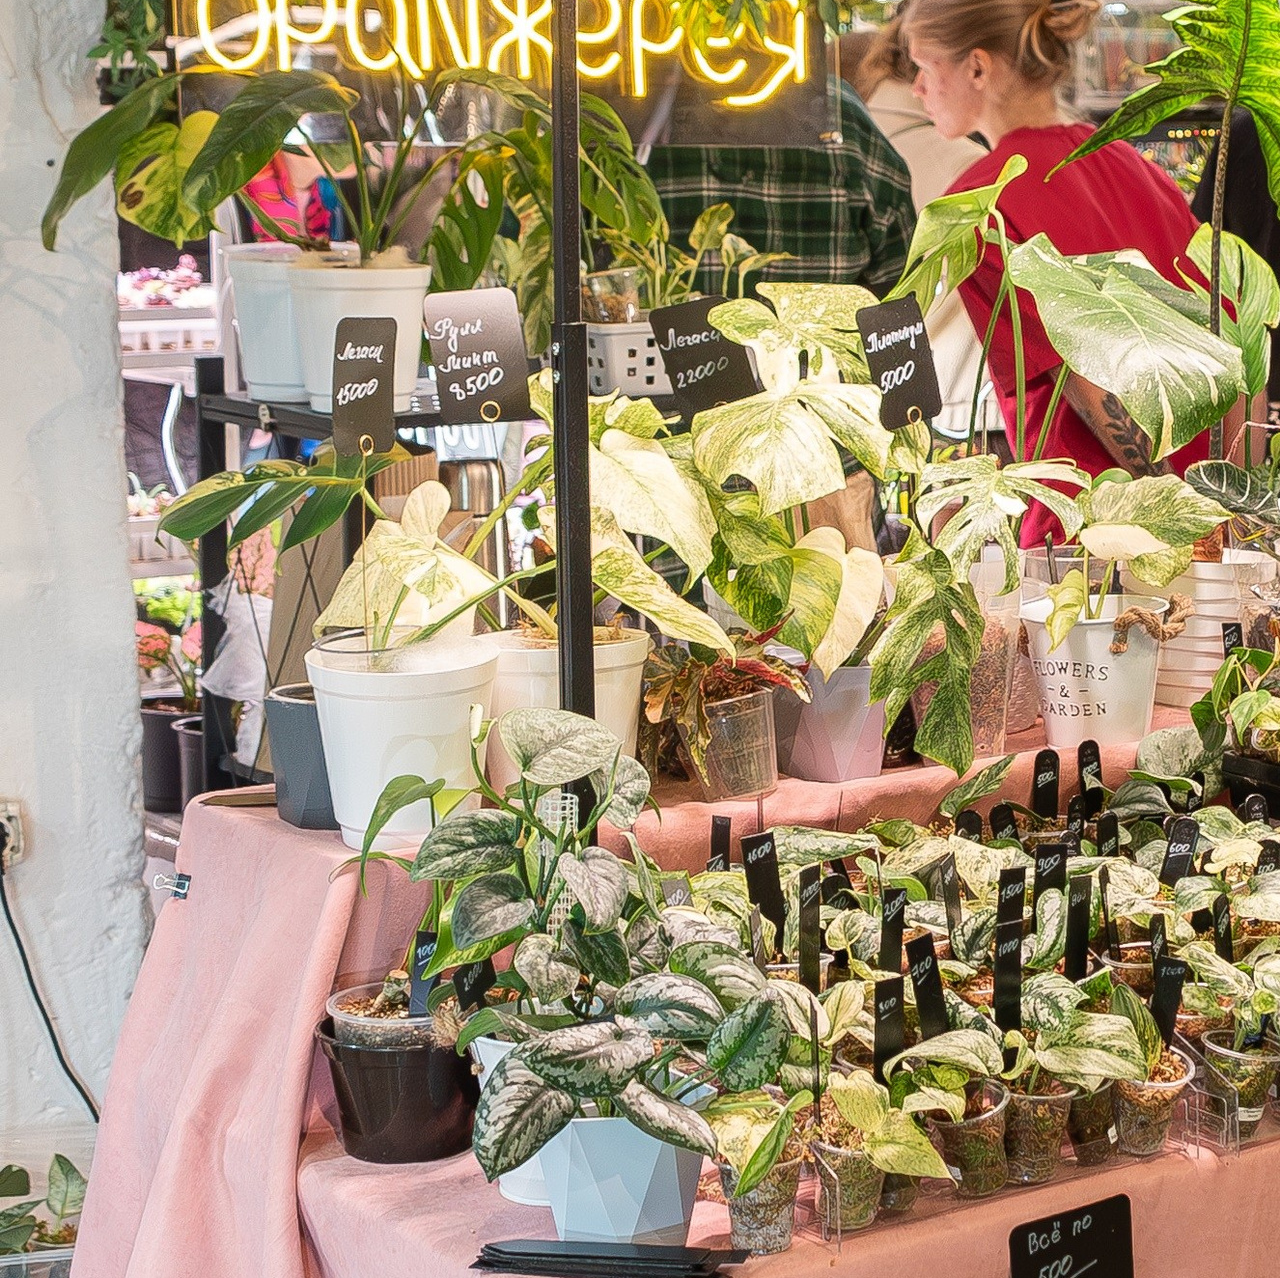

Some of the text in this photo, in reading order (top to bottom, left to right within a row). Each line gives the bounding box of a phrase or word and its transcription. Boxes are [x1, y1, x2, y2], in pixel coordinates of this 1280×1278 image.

[448, 366, 505, 401] 8500
[676, 356, 730, 390] 22000
[880, 359, 916, 395] 5000
[336, 377, 379, 406] 15000
[1033, 660, 1109, 681] FLOWERS
[1041, 699, 1108, 717] GARDEN
[1037, 770, 1055, 784] 500
[747, 841, 773, 864] 1600
[1169, 842, 1191, 854] 600
[1037, 853, 1061, 873] 900
[884, 890, 907, 916] 2000
[999, 938, 1019, 958] 1000
[911, 954, 933, 978] 700
[1028, 1214, 1093, 1255] Всё по
